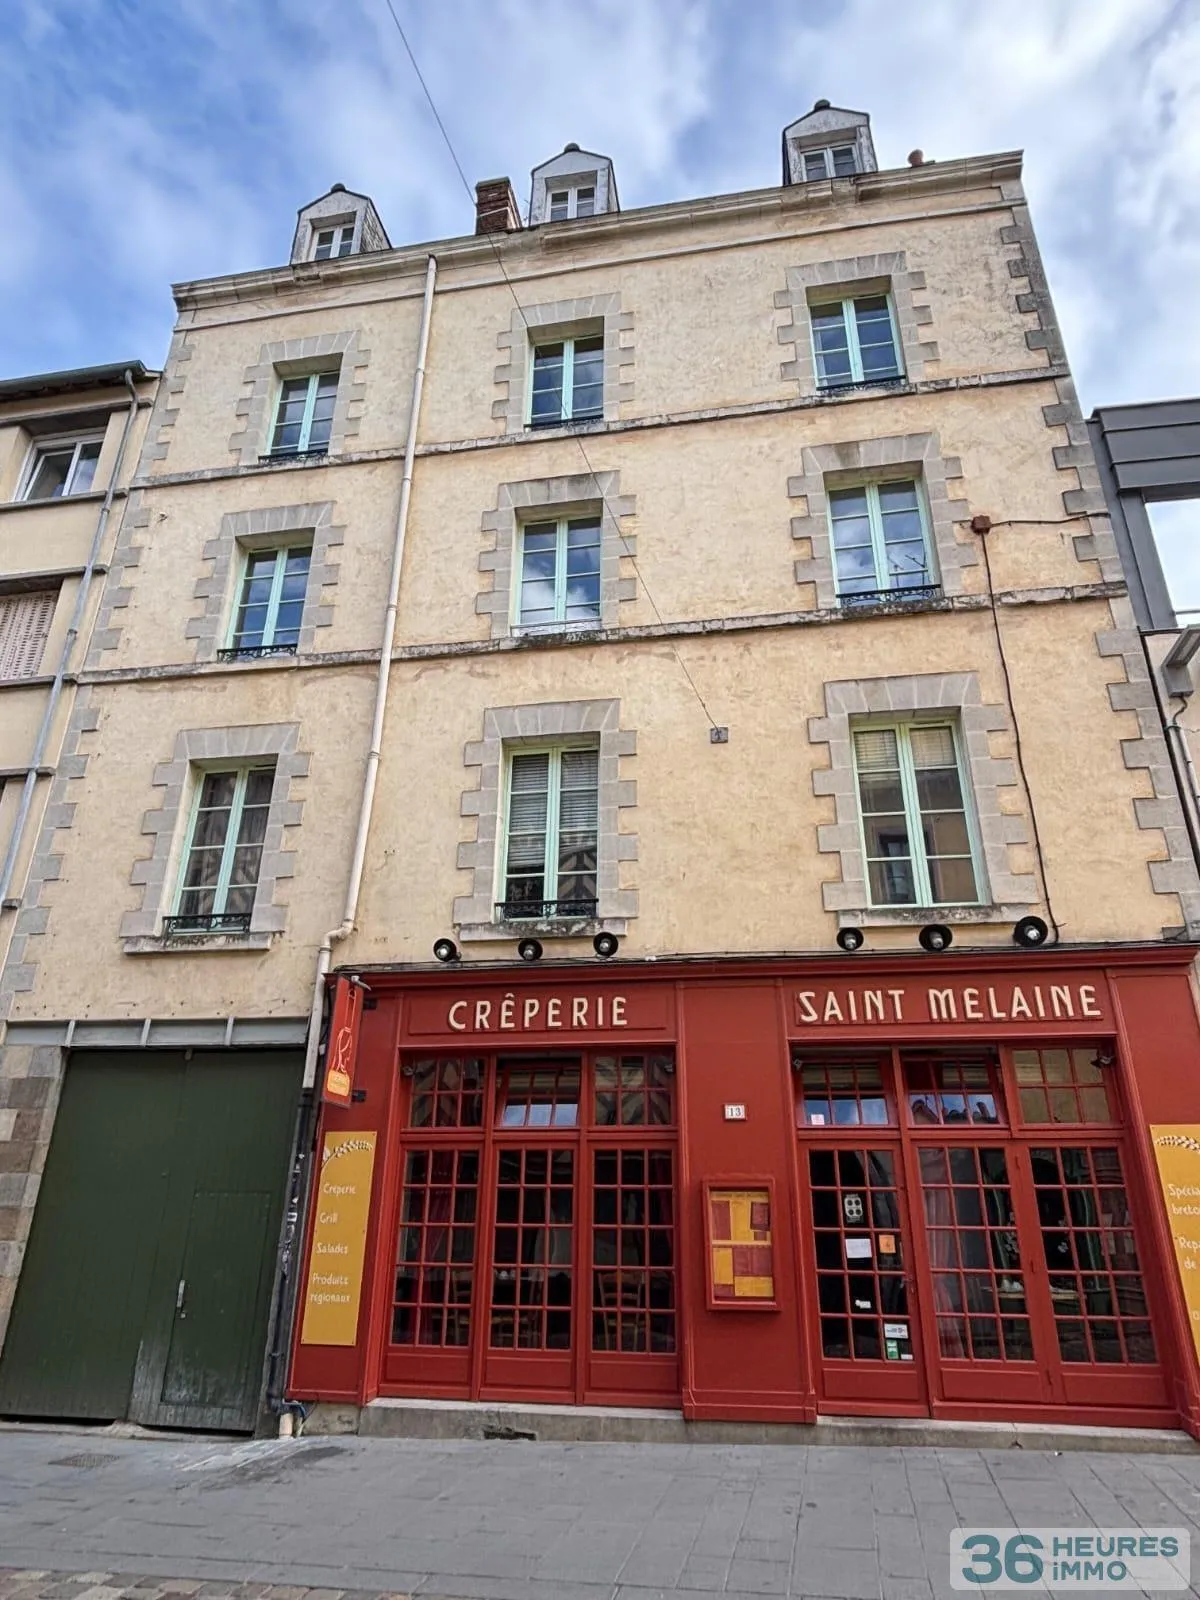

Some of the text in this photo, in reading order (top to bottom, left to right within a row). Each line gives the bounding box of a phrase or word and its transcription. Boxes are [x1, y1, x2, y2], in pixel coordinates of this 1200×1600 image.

[799, 985, 1102, 1022] SAINT MELAINE
[448, 993, 628, 1030] CRÊPERIE
[319, 1212, 338, 1224] Grill
[316, 1241, 349, 1254] Salades
[1184, 1257, 1197, 1269] de
[312, 1272, 349, 1285] Produits
